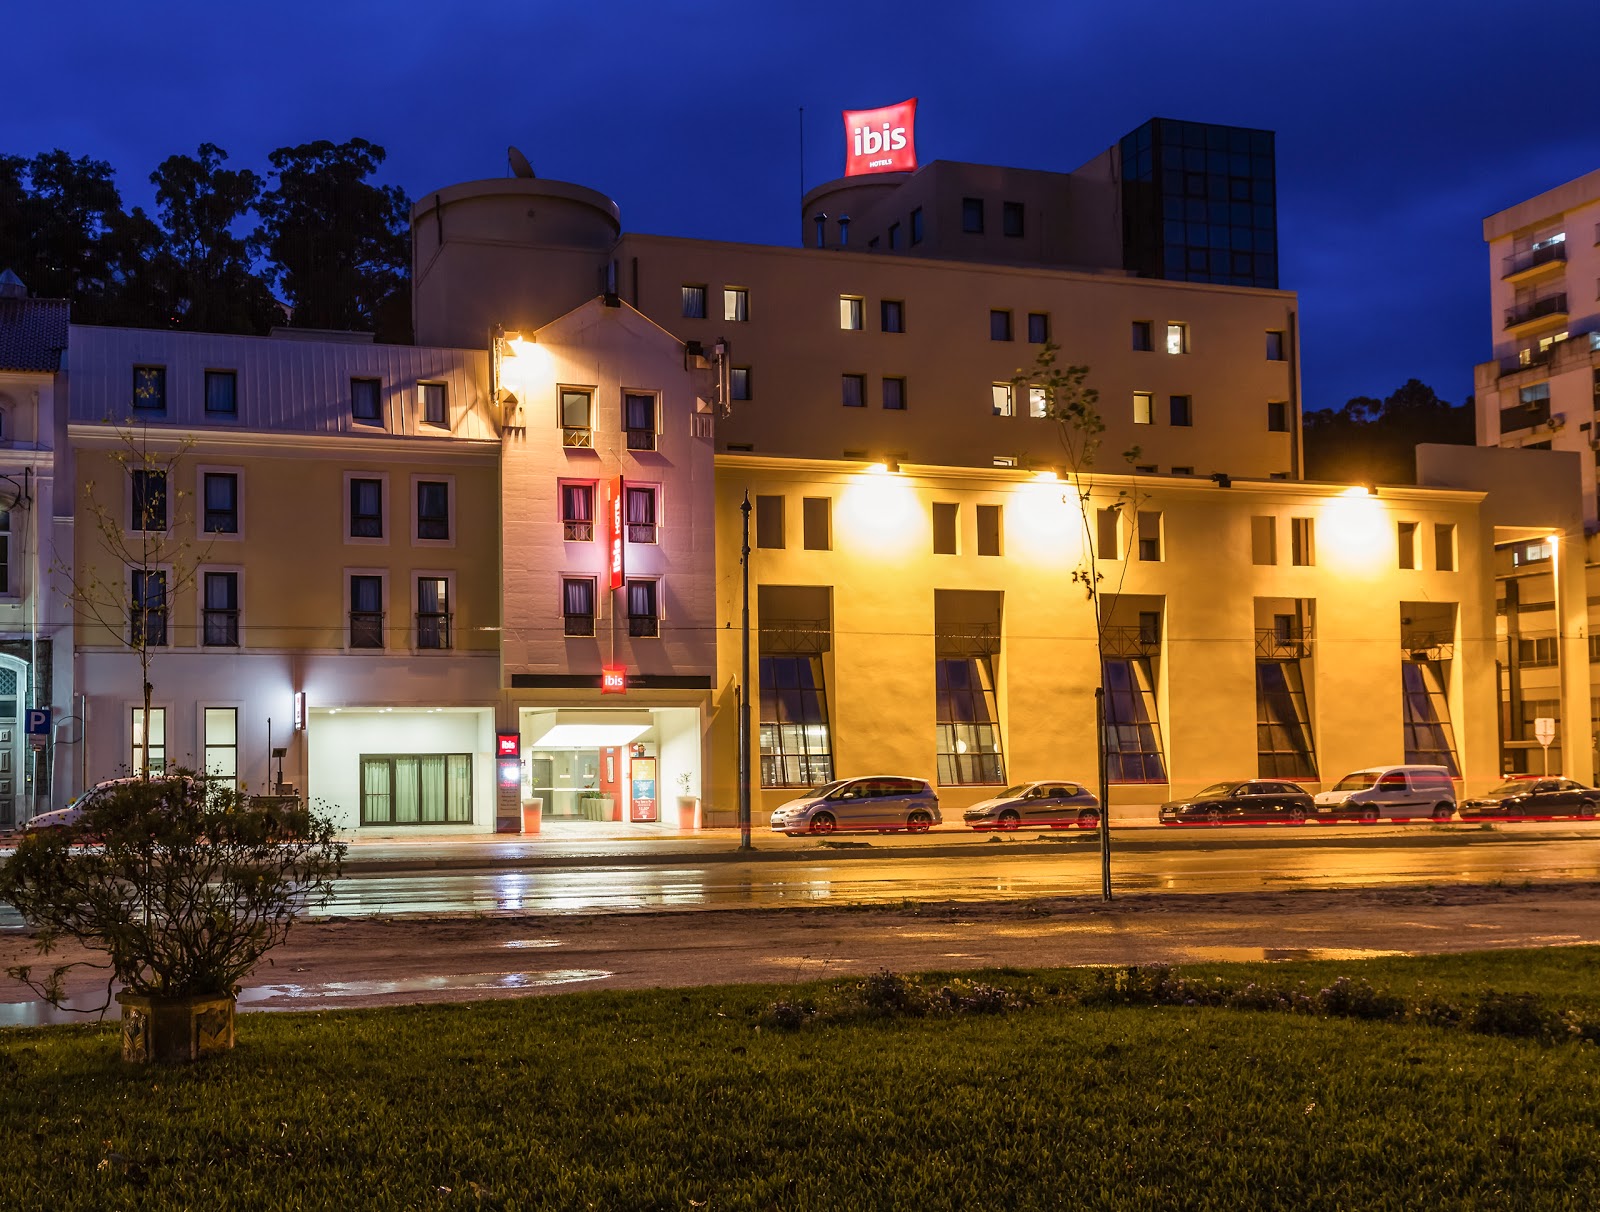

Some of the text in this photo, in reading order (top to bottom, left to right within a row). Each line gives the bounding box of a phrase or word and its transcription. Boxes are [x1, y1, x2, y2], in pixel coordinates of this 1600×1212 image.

[854, 122, 907, 156] ibis
[869, 158, 893, 168] HOTELS
[613, 538, 621, 573] ibis
[604, 675, 623, 686] ibis
[30, 711, 46, 732] P
[501, 740, 516, 749] ibis
